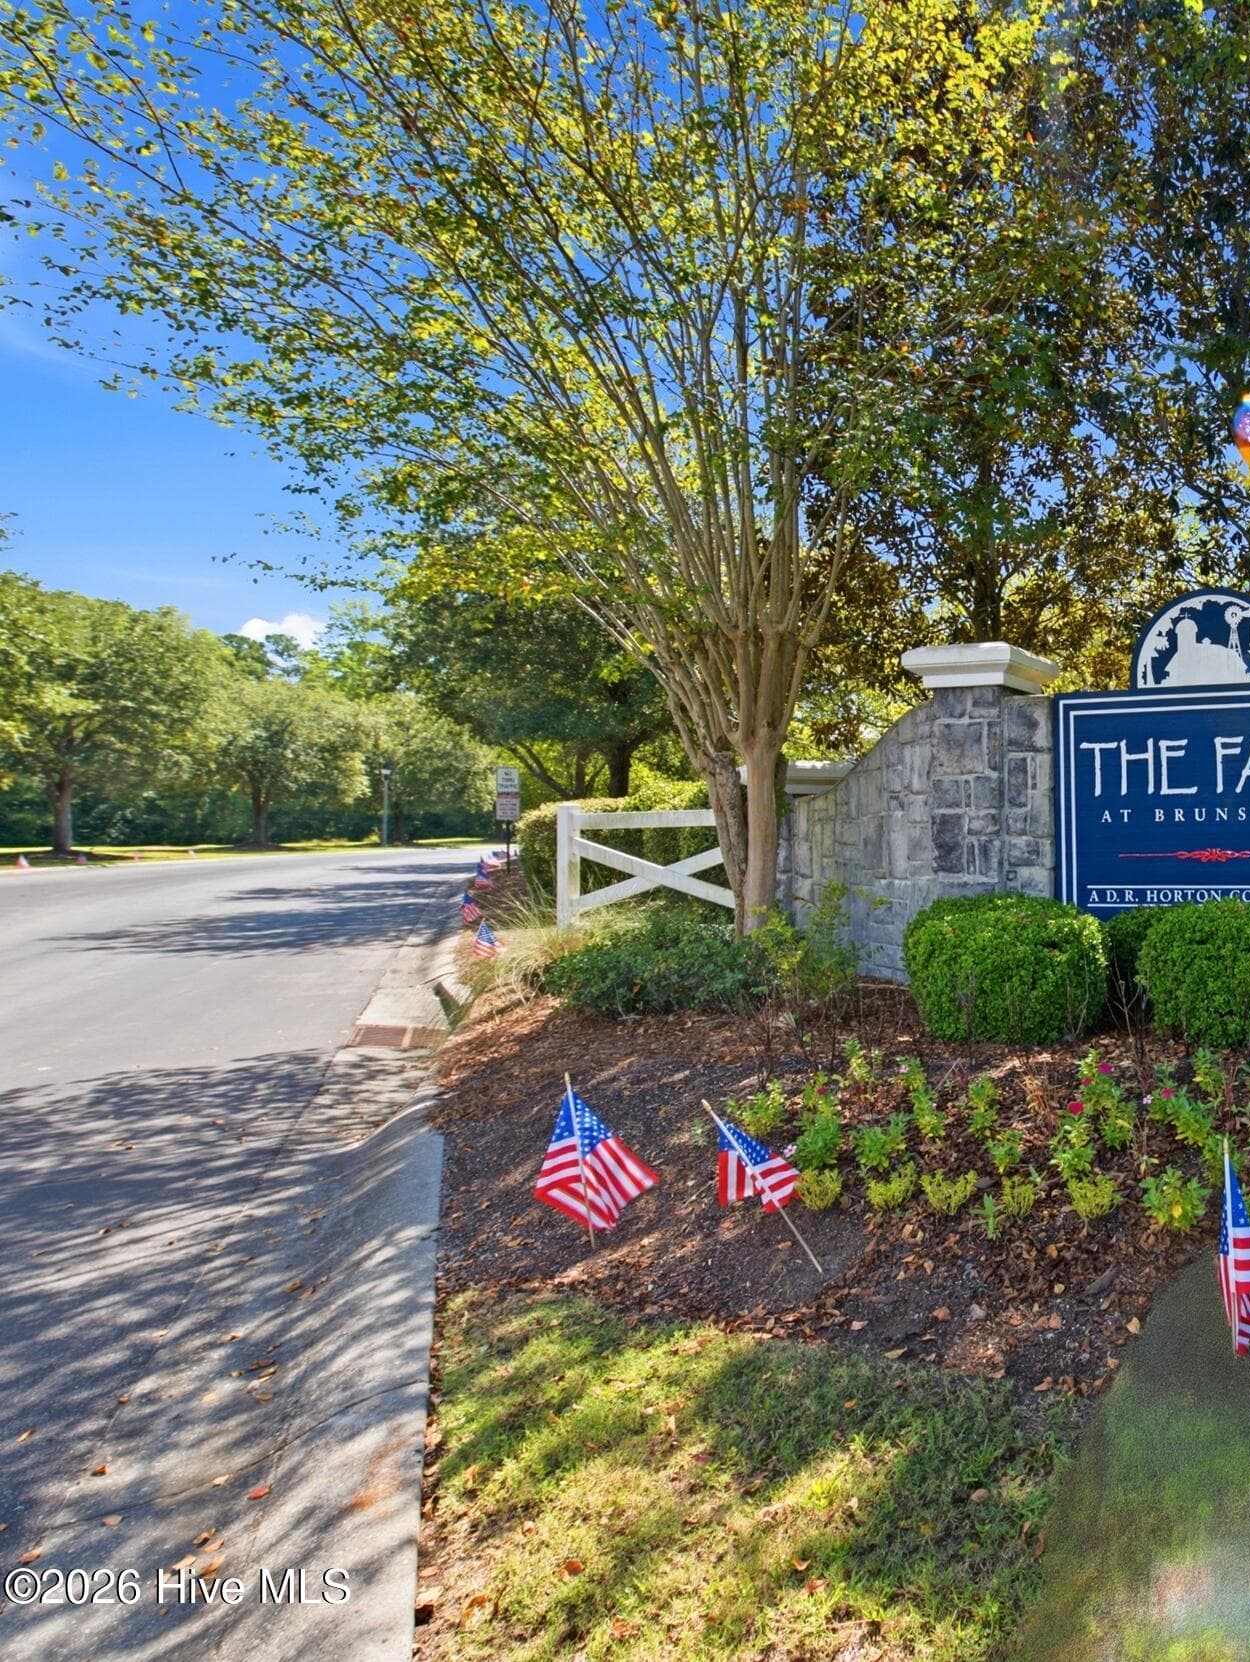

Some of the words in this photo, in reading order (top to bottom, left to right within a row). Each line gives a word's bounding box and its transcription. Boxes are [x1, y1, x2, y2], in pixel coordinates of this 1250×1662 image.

[1080, 737, 1198, 797] THE
[1101, 809, 1132, 823] AT
[1089, 890, 1099, 902] A
[1146, 889, 1222, 902] HORTON
